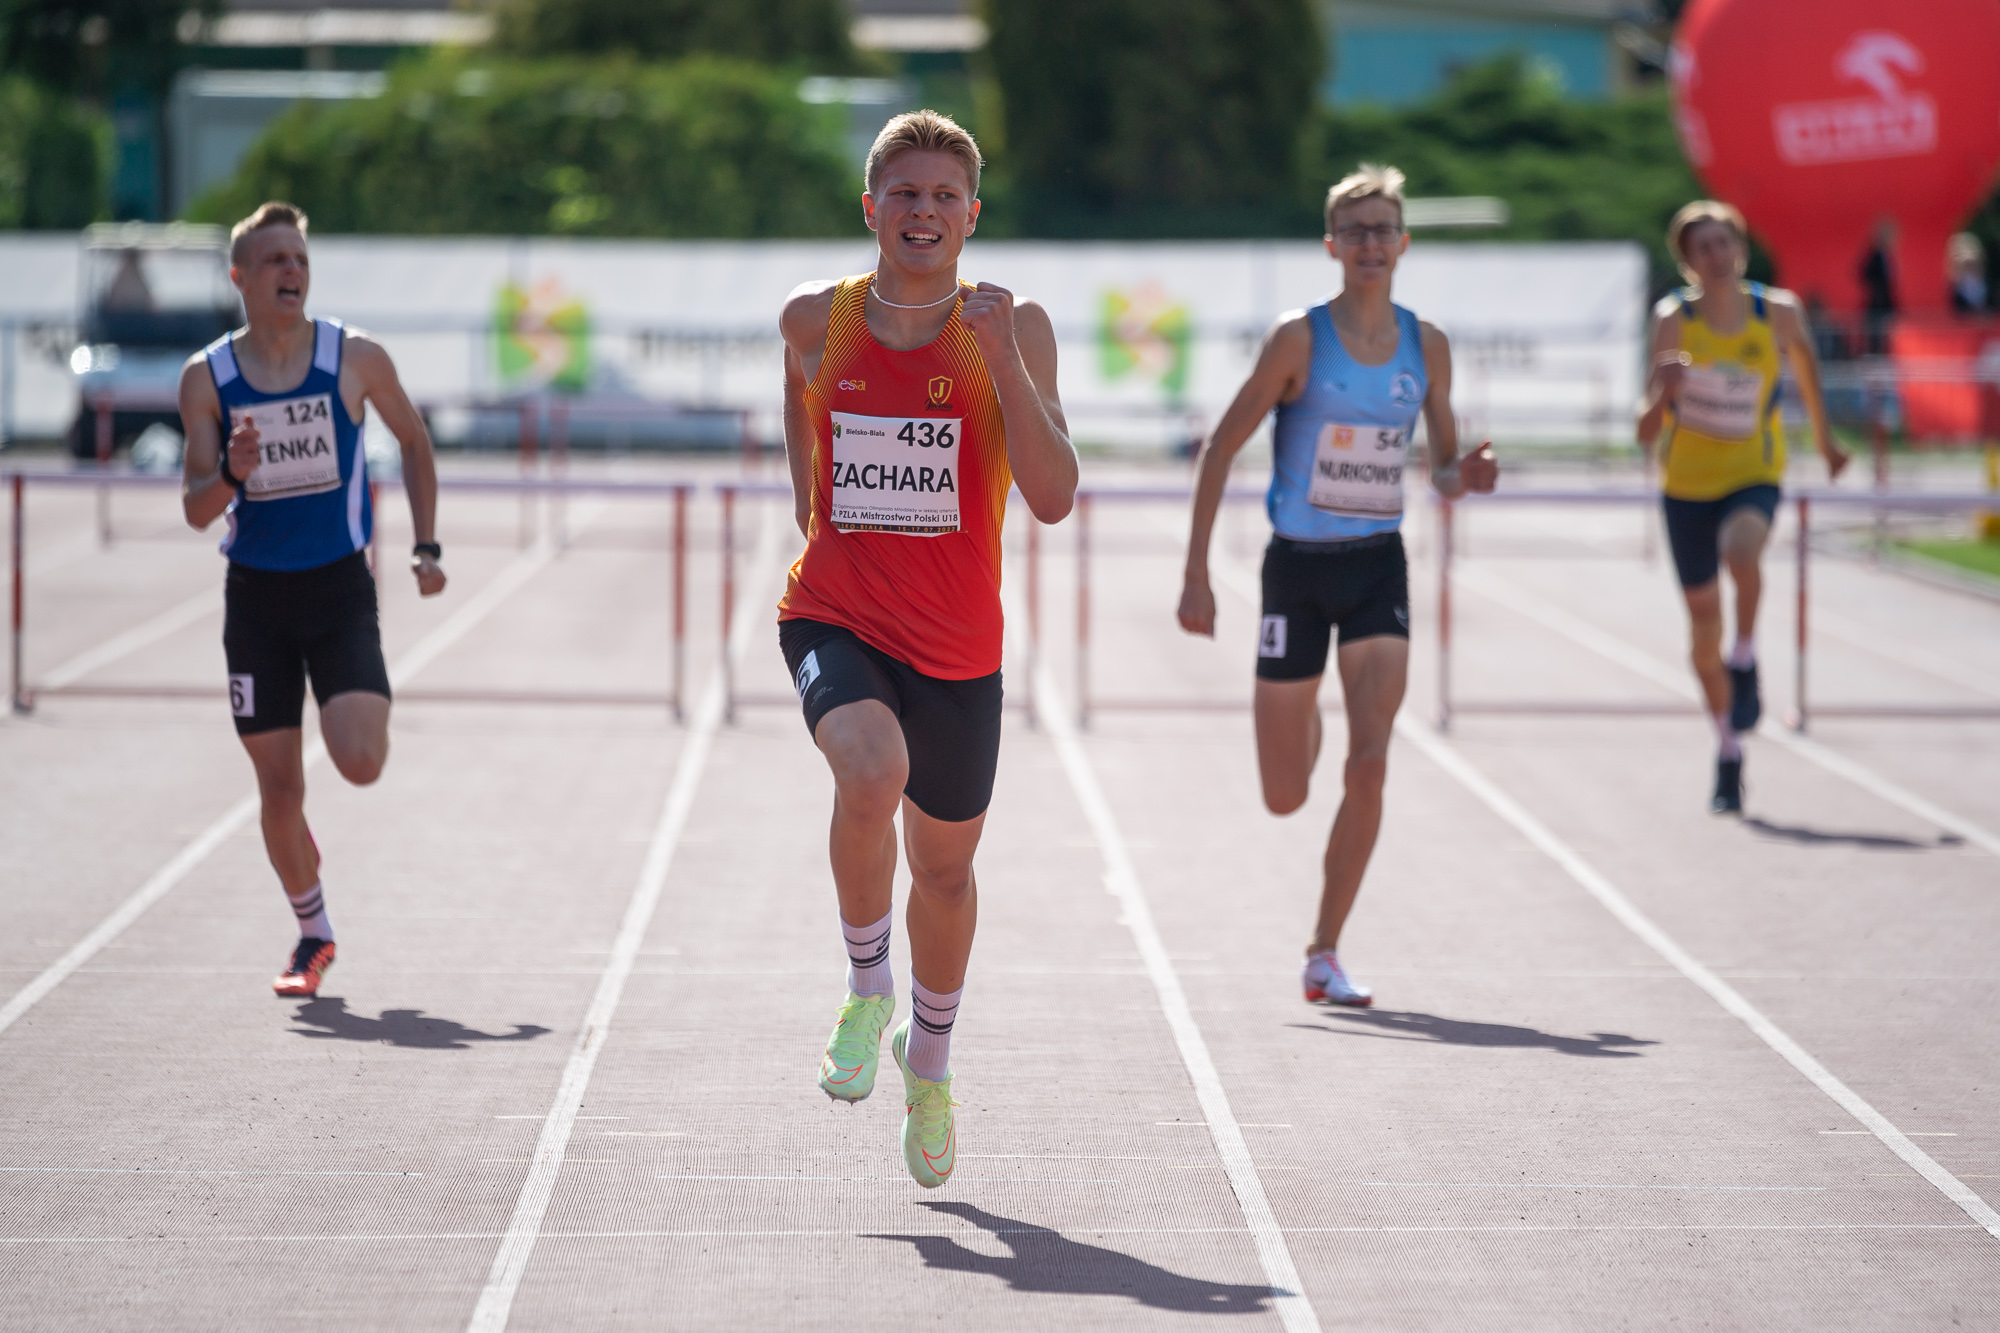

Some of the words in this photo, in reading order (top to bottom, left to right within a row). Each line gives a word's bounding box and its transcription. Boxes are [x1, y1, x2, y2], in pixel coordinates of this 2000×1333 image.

[933, 381, 945, 398] J
[284, 400, 329, 426] 124
[896, 421, 955, 449] 436
[833, 461, 955, 493] ZACHARA
[839, 510, 858, 519] PZLA
[860, 511, 912, 522] Mistrzostwa
[914, 514, 940, 522] Polski
[942, 514, 958, 523] U18
[1264, 622, 1276, 650] 4
[229, 679, 245, 713] 6
